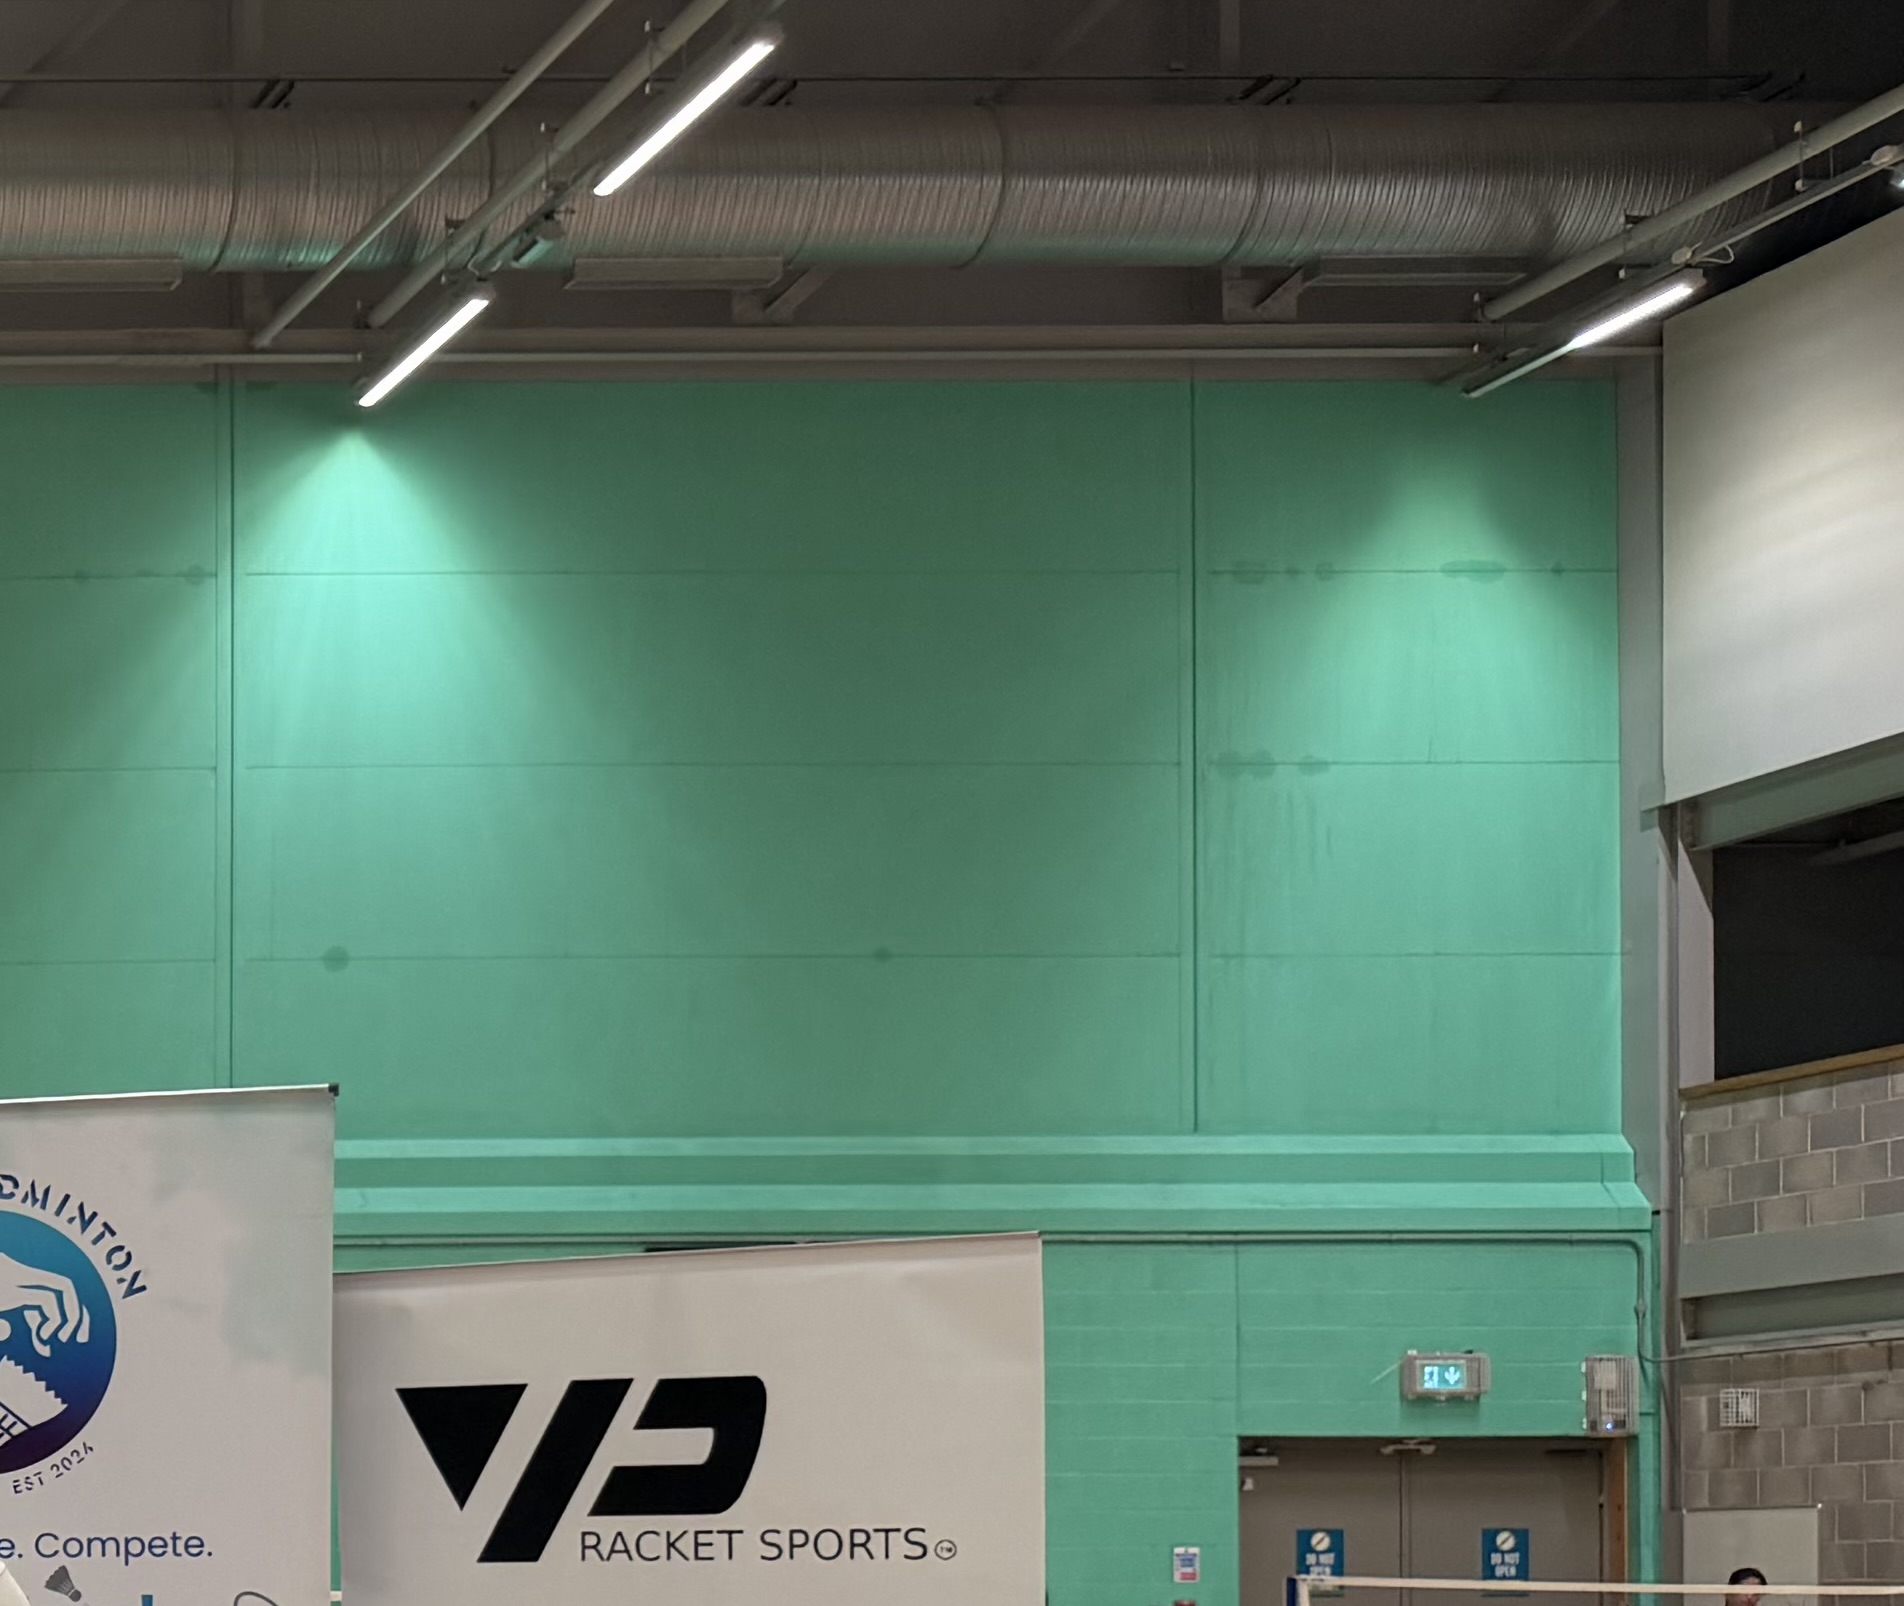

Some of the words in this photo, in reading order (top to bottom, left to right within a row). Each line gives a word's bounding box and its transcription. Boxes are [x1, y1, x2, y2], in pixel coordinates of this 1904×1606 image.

[13, 1477, 43, 1494] EST
[51, 1442, 93, 1478] 2024
[35, 1532, 212, 1566] Compete.
[581, 1530, 744, 1561] RACKET
[760, 1528, 927, 1561] SPORTS
